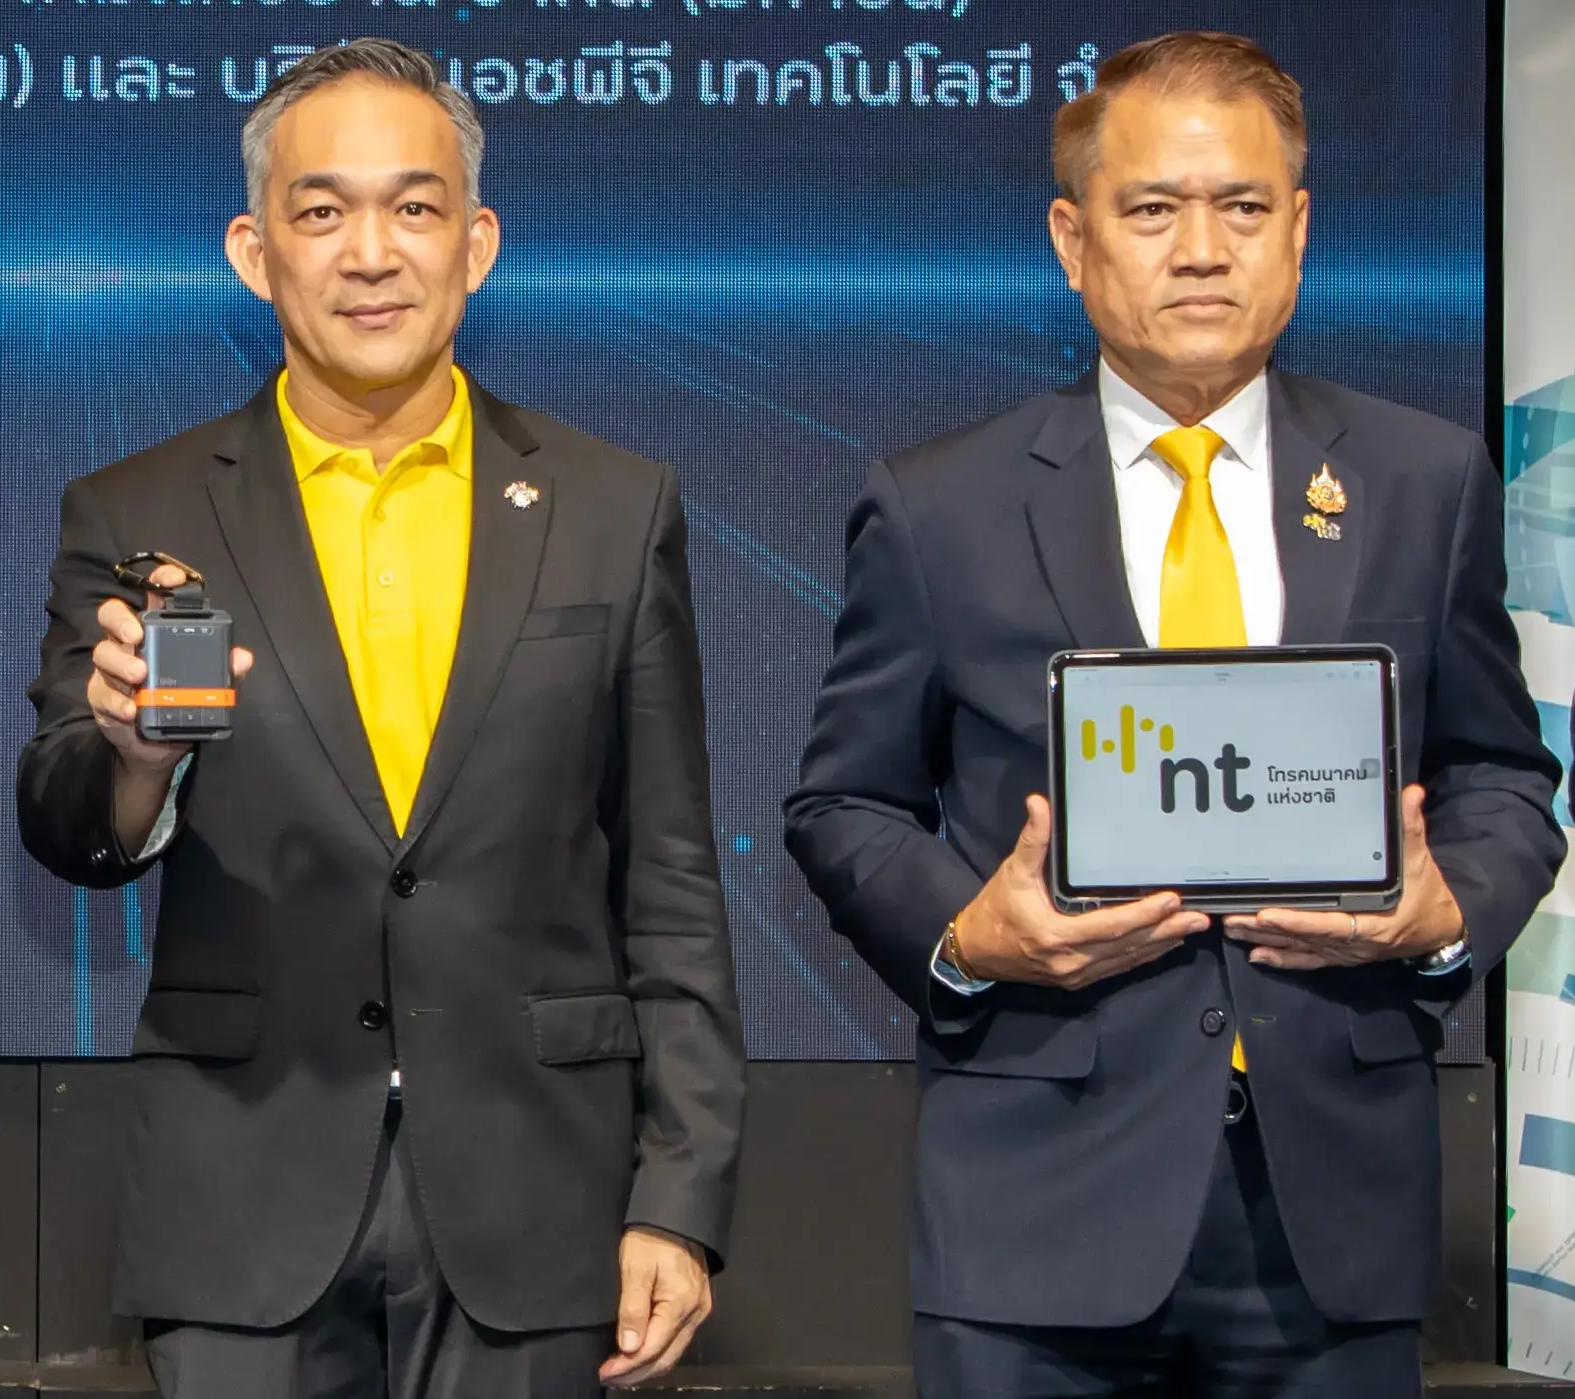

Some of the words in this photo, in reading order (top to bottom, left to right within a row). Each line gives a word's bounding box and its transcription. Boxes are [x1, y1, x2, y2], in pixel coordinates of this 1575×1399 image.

[62, 55, 216, 102] และ
[700, 42, 1033, 106] เทคโนโลยี
[1159, 743, 1255, 814] nt
[1267, 765, 1368, 783] โทรคมนาคม
[1267, 786, 1336, 804] แห่งชาติ
